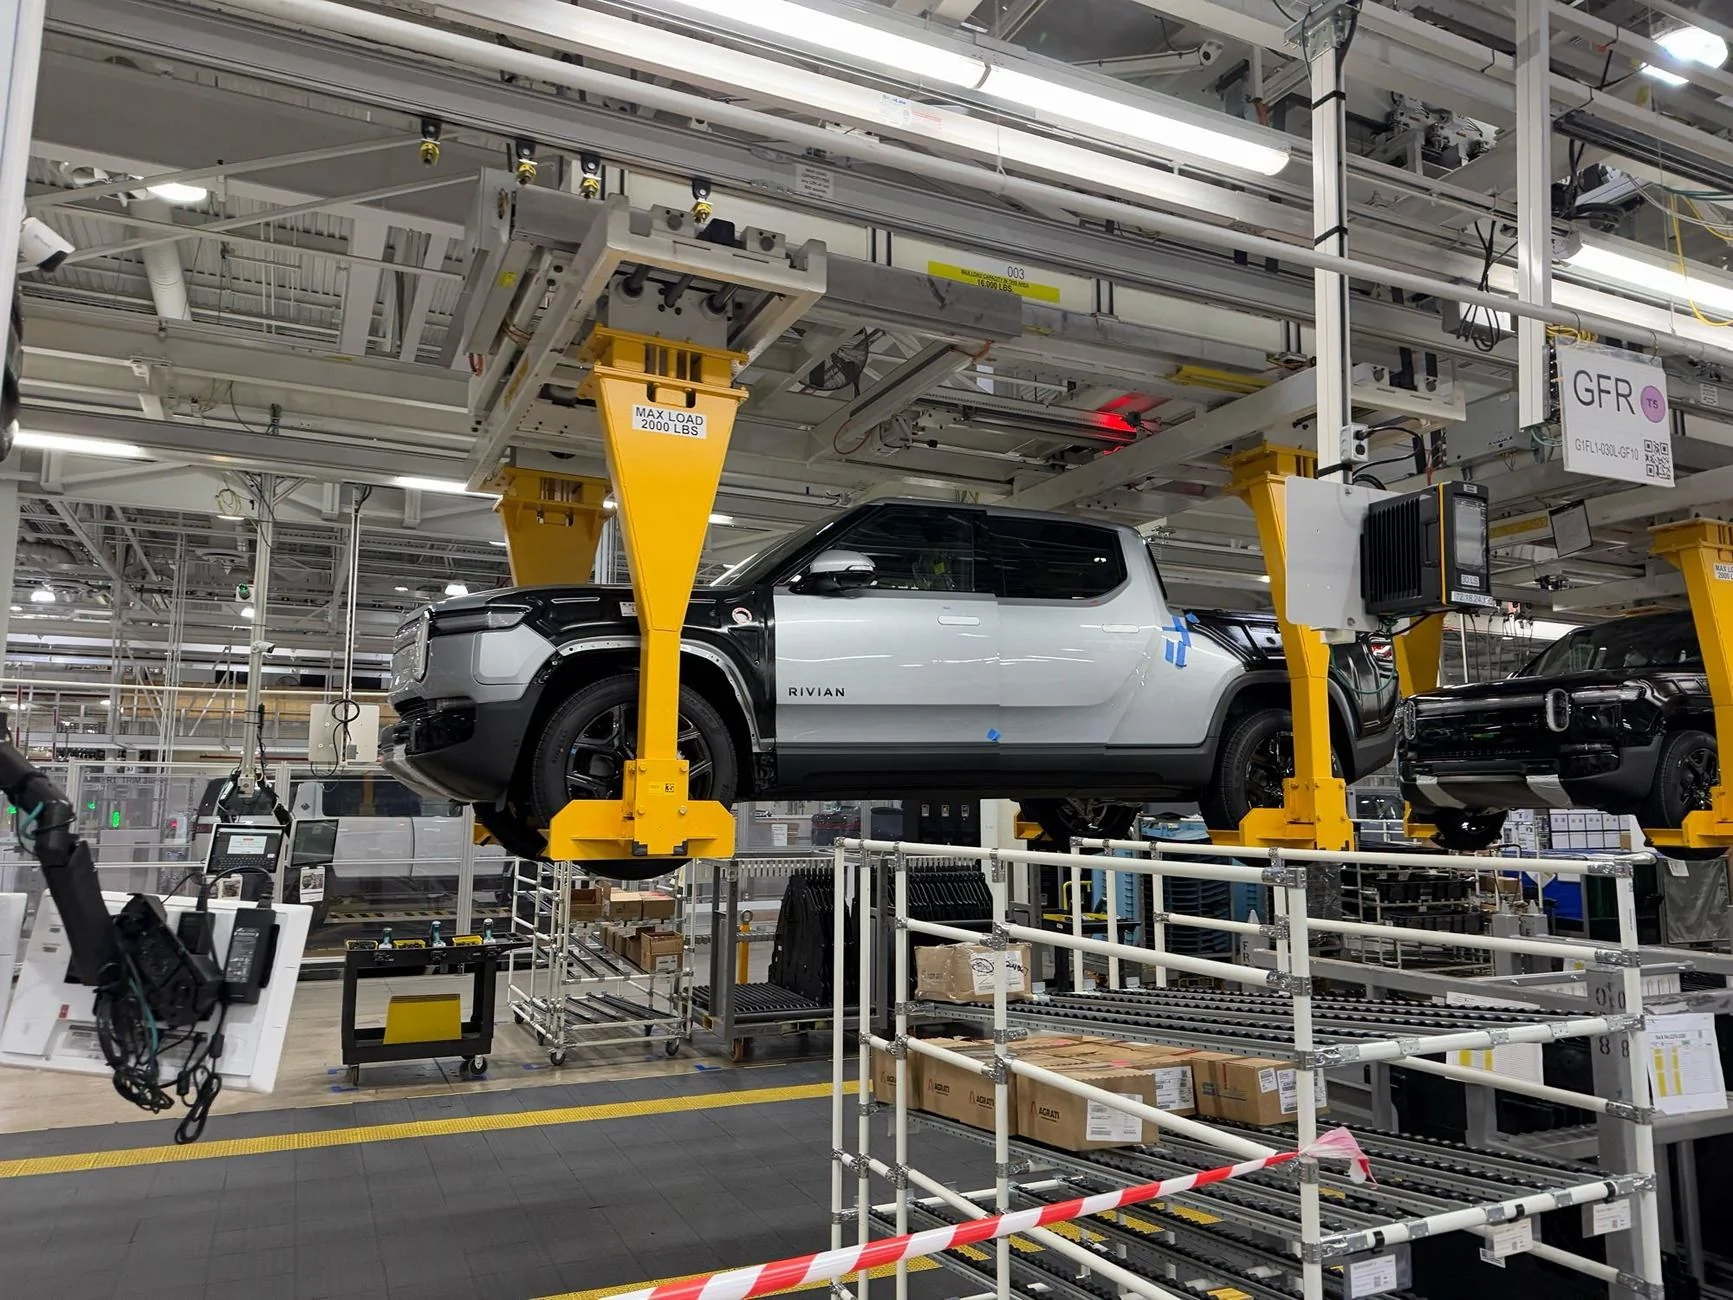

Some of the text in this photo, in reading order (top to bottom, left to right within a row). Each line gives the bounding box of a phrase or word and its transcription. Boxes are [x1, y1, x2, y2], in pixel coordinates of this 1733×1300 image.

[1007, 265, 1025, 280] 003
[1573, 369, 1636, 415] GFR
[635, 406, 704, 426] MAX LOAD
[641, 418, 699, 436] 2000 LBS
[788, 687, 845, 697] RIVIAN
[1038, 1106, 1060, 1120] AGRATI
